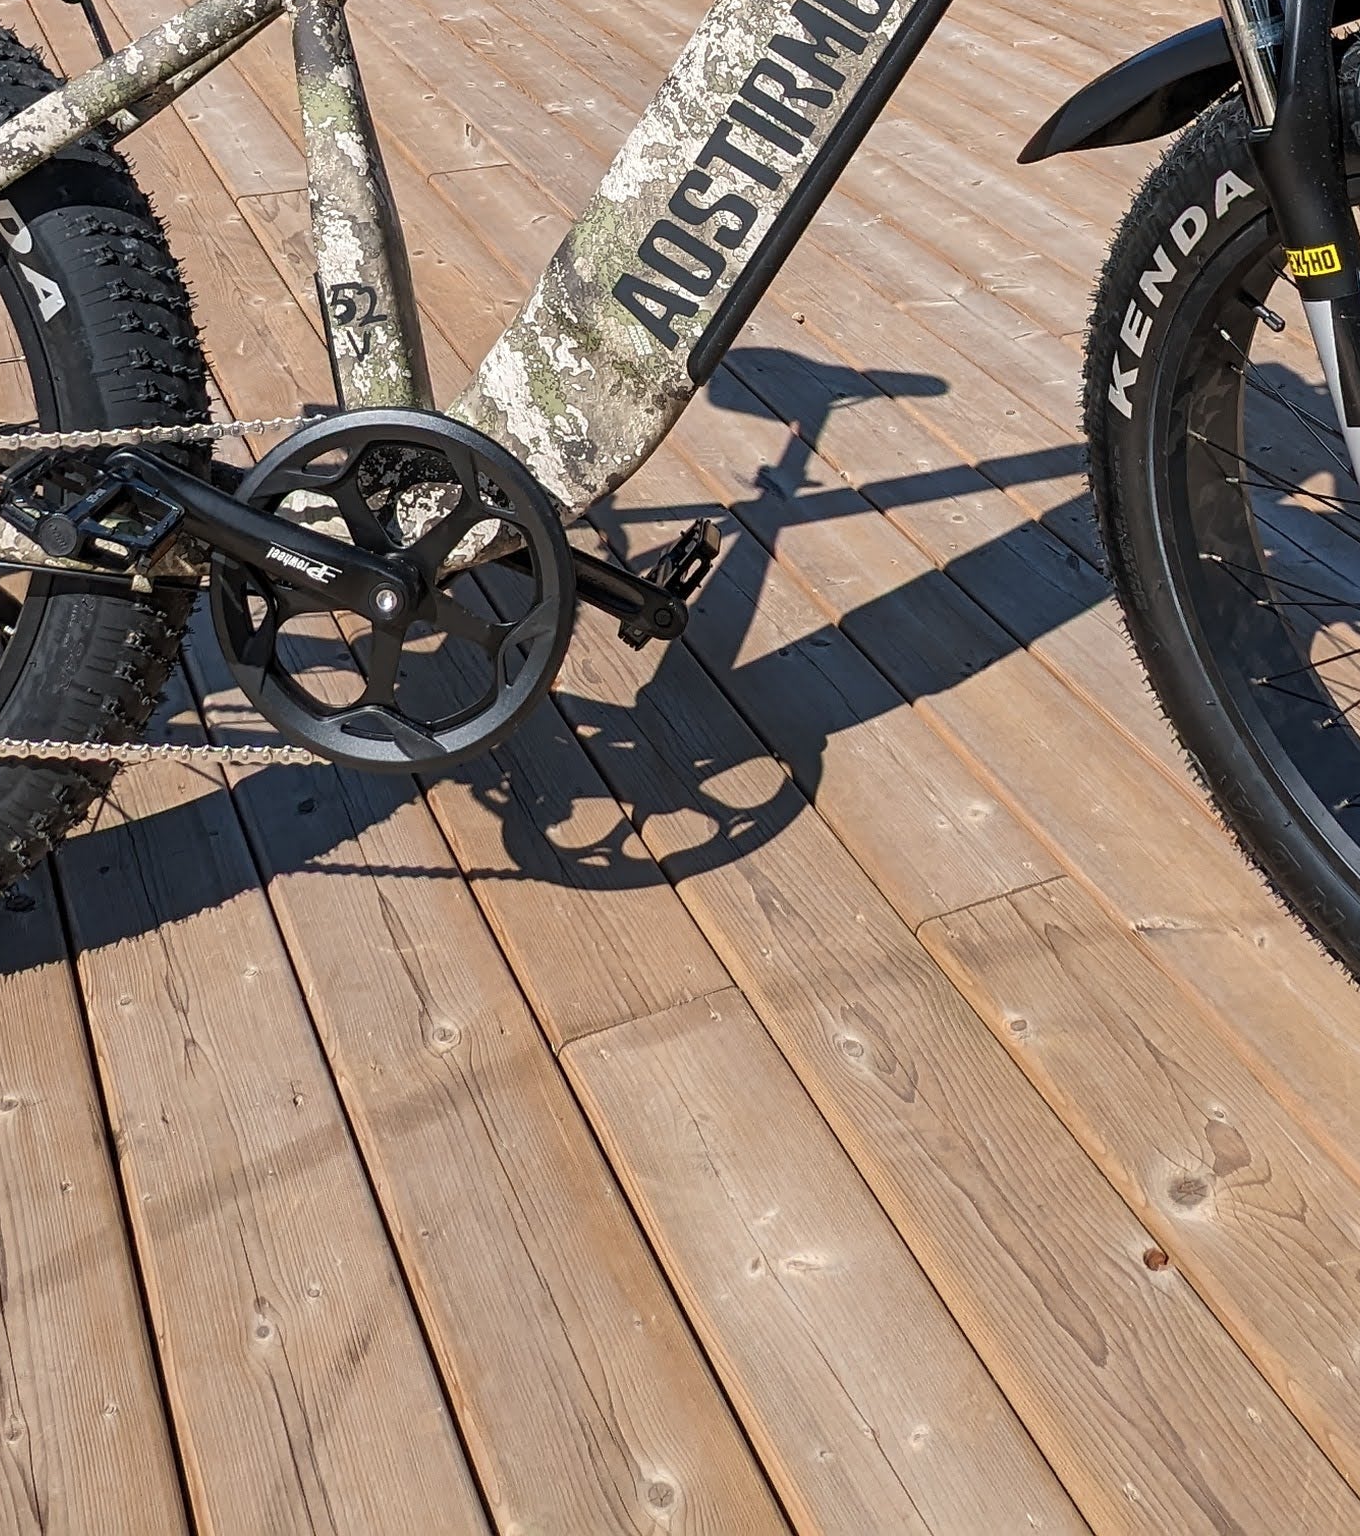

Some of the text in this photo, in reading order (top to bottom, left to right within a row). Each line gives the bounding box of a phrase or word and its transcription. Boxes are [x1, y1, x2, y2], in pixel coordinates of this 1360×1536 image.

[329, 281, 388, 327] 52
[1107, 168, 1255, 420] KENDA
[346, 330, 372, 362] V
[266, 542, 342, 584] Prowheel
